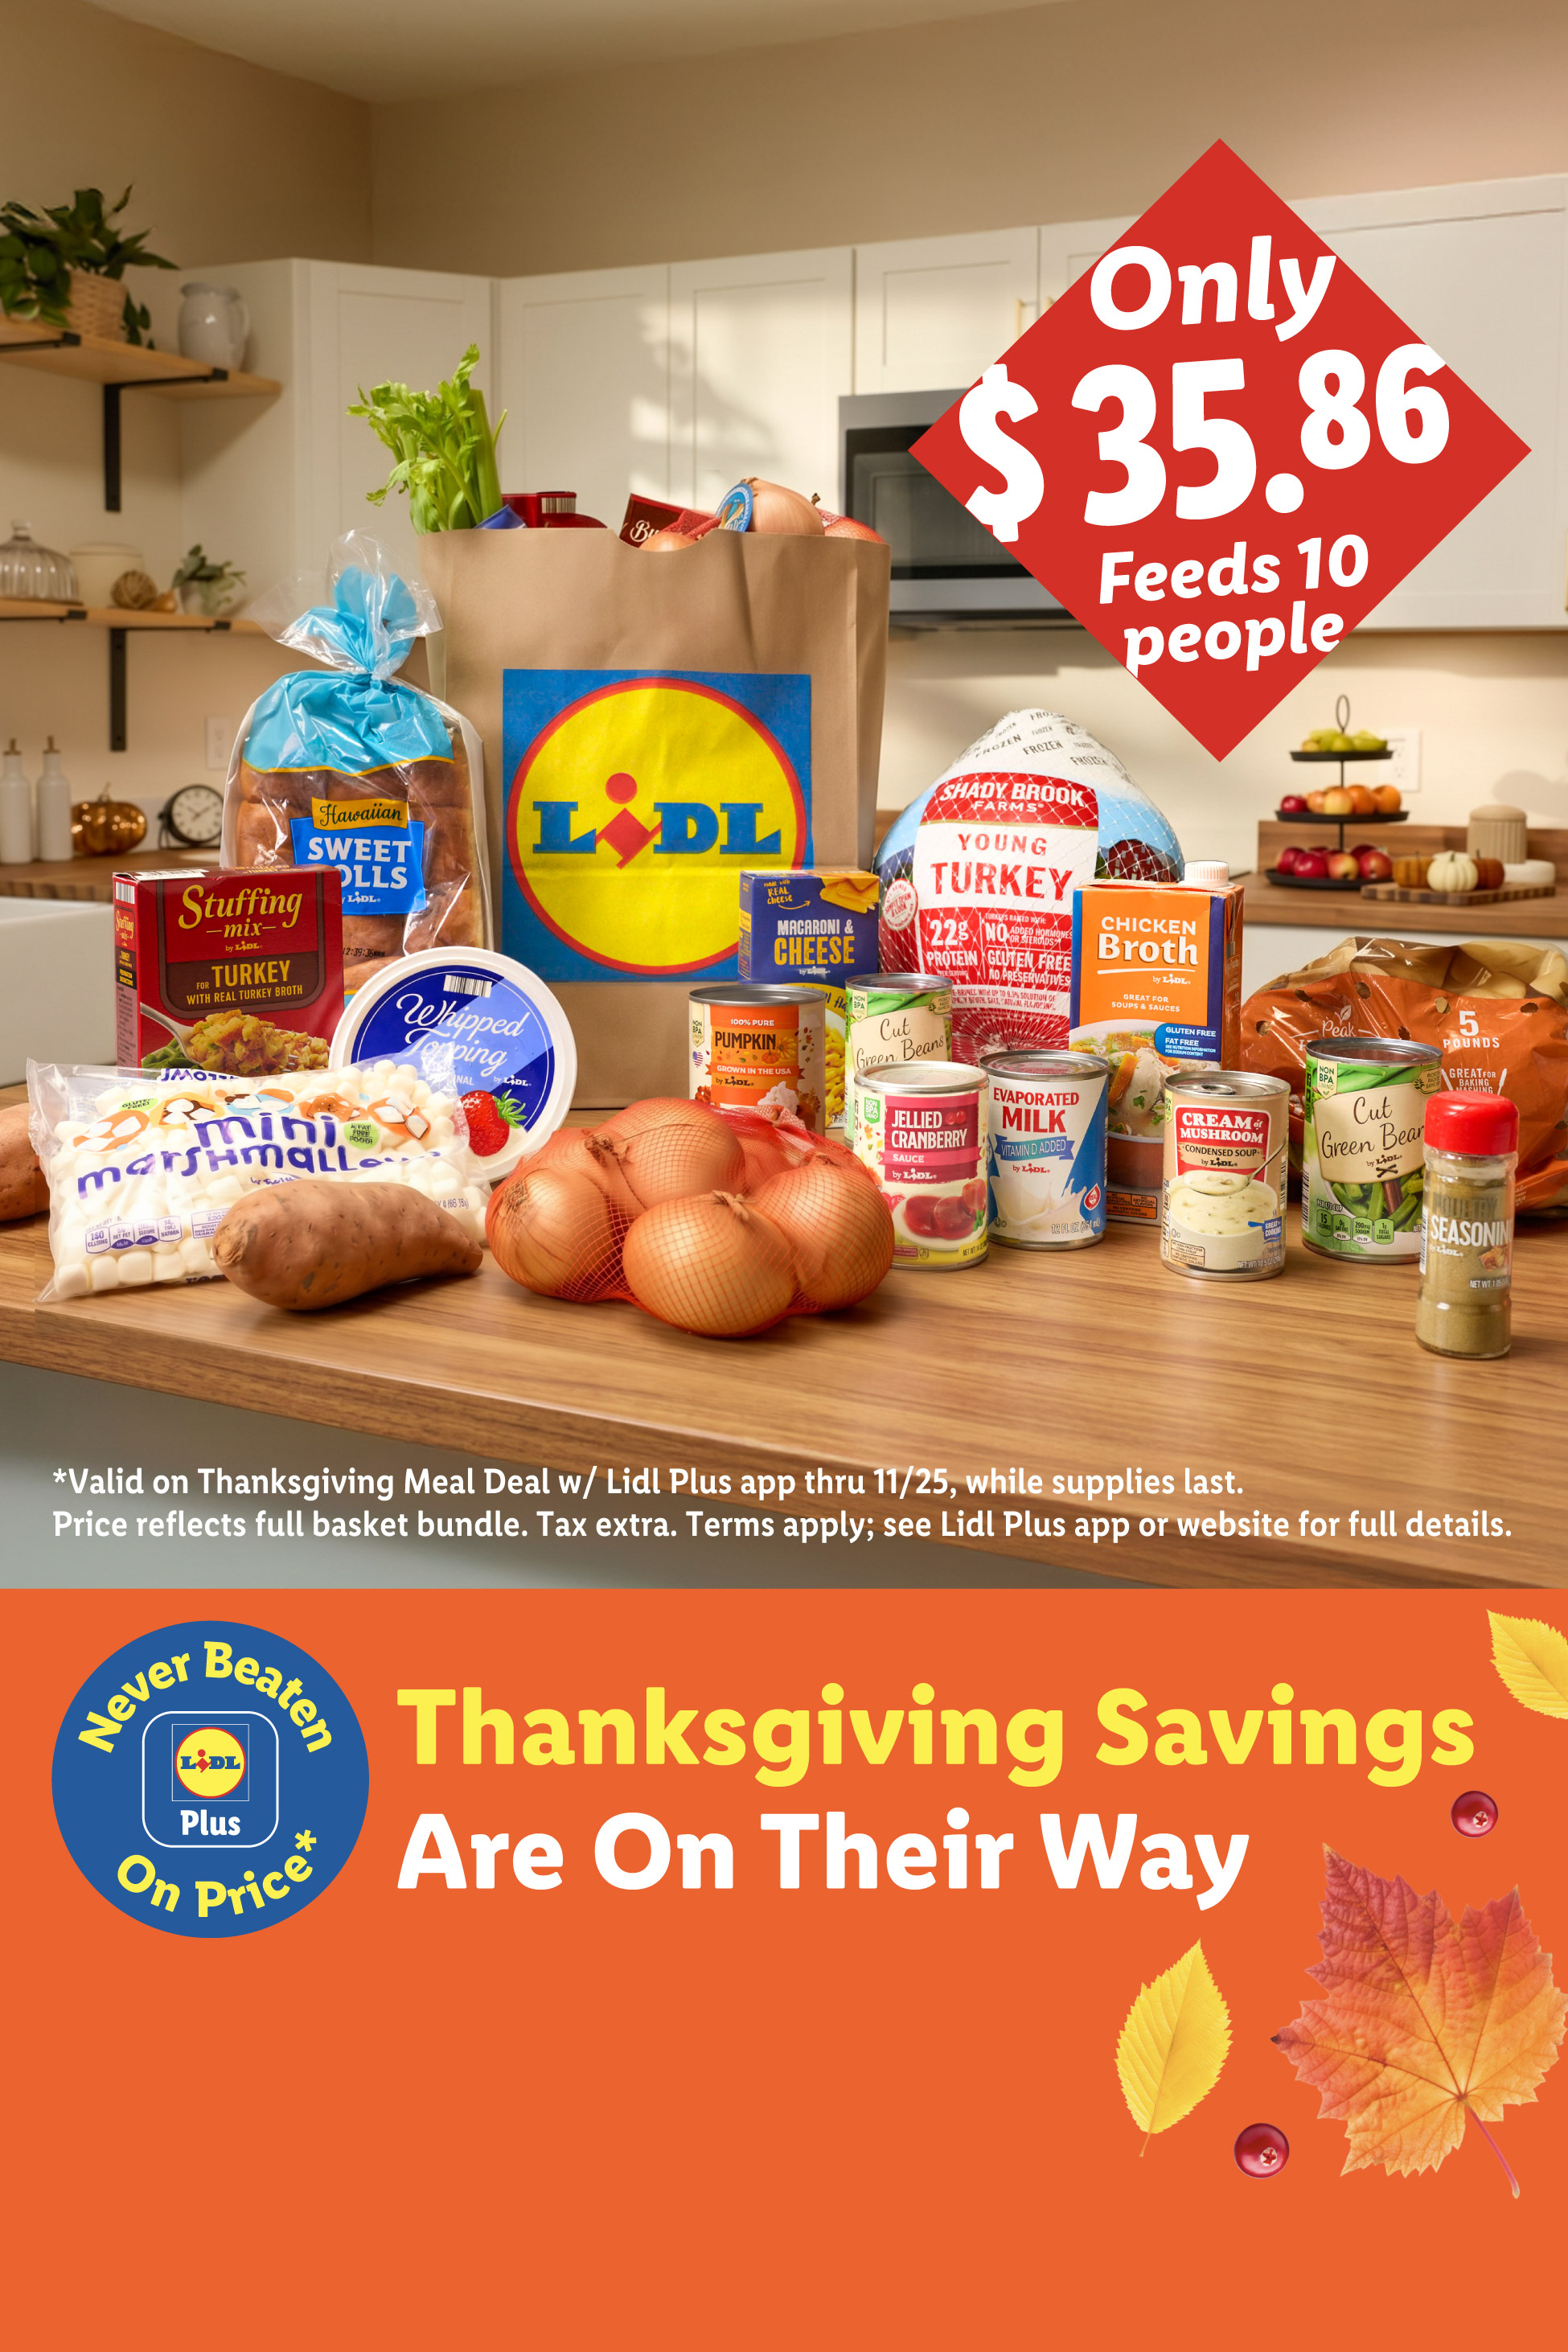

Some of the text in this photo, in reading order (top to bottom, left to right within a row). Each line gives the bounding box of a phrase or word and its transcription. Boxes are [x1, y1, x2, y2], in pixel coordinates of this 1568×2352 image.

[975, 734, 1022, 757] FROZEN
[1023, 740, 1064, 755] FROZEN
[939, 782, 1086, 807] SHADY BROOK
[319, 802, 403, 827] Hawaiian
[307, 836, 413, 863] SWEET
[957, 833, 1048, 856] YOUNG
[336, 864, 408, 889] OLLS
[930, 862, 1073, 901] TURKEY
[767, 886, 790, 897] REAL
[767, 894, 793, 905] cheese
[178, 885, 303, 930] Stuffing
[223, 917, 263, 939] mix
[777, 918, 854, 936] MACARONI &
[930, 919, 1073, 946] 22g NO ADDED HORMONES
[1101, 916, 1197, 936] CHICKEN
[1010, 934, 1020, 943] OR
[225, 944, 234, 953] by
[774, 935, 856, 966] CHEESE
[1097, 933, 1199, 967] Broth
[926, 949, 1072, 972] PROTEIN GLUTEN FREE
[196, 959, 291, 991] FOR TURKEY
[988, 968, 1071, 987] NO PRESERVATIVES
[1152, 975, 1161, 984] by
[186, 984, 303, 1005] WITH REAL TURKEY BROTH
[1123, 993, 1169, 1004] GREAT FOR
[853, 1001, 865, 1010] BPA
[1111, 1001, 1139, 1010] SOUPS
[1148, 1004, 1180, 1012] SAUCES
[396, 993, 531, 1040] Whipped
[730, 1018, 751, 1026] 100%
[1459, 1010, 1480, 1036] 5
[880, 1017, 911, 1041] Cut
[1165, 1026, 1217, 1037] GLUTEN FREE
[1321, 1018, 1357, 1037] Peak
[715, 1031, 777, 1050] PUMPKIN
[900, 1035, 945, 1061] Beans
[1164, 1037, 1200, 1047] FAT FREE
[1443, 1037, 1500, 1049] POUNDS
[716, 1065, 746, 1074] GROWN
[1319, 1066, 1335, 1075] NON
[1449, 1068, 1483, 1078] GREAT
[493, 1075, 503, 1086] by
[715, 1077, 724, 1086] by
[1319, 1073, 1334, 1085] BPA
[1459, 1078, 1490, 1087] BAKING
[993, 1087, 1080, 1106] EVAPORATED
[865, 1106, 879, 1115] BPA
[1353, 1096, 1393, 1125] Cut
[891, 1110, 942, 1129] JELLIED
[1002, 1106, 1067, 1134] MILK
[1181, 1112, 1263, 1130] CREAM of
[193, 1111, 336, 1149] mini
[1180, 1127, 1264, 1143] MUSHROOM
[891, 1128, 967, 1150] CRANBERRY
[1321, 1131, 1376, 1159] Green
[1000, 1139, 1066, 1157] VITAMIN D ADDED
[1184, 1144, 1257, 1157] CONDENSED SOUP
[893, 1154, 925, 1164] SAUCE
[1201, 1159, 1209, 1167] by
[892, 1171, 901, 1180] by
[1012, 1164, 1020, 1173] by
[1333, 1203, 1344, 1213] CUP
[1051, 1223, 1061, 1234] 12
[1265, 1221, 1279, 1229] GREAT
[1320, 1213, 1371, 1230] 15 290mg
[1265, 1226, 1282, 1237] COOKING
[1469, 1279, 1492, 1289] NET WT
